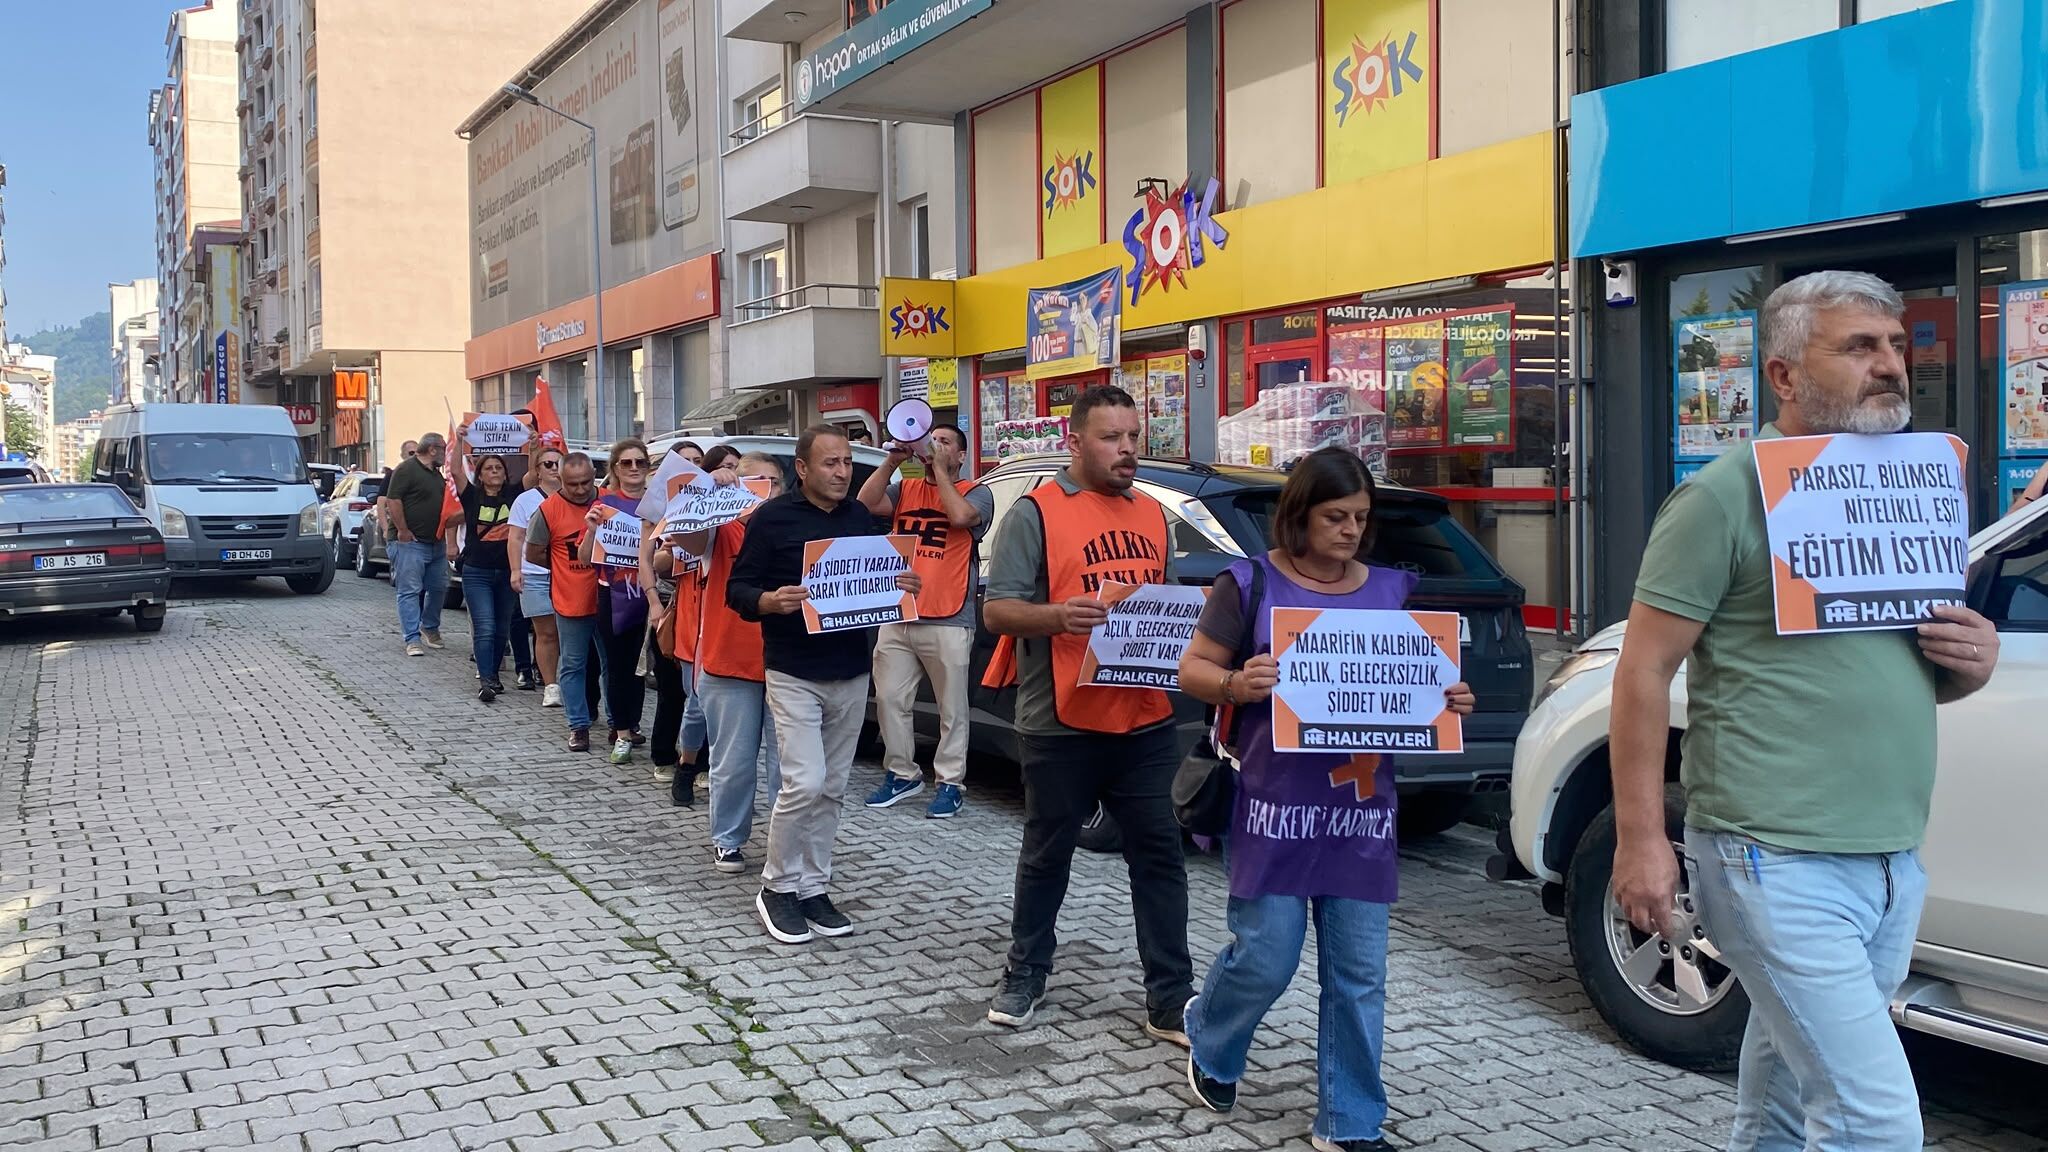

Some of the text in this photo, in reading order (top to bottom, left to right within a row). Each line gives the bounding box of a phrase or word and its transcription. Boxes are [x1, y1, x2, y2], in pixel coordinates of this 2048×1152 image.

[857, 39, 881, 64] ORTAK
[881, 23, 908, 52] SAĞLIK
[908, 17, 919, 36] VE
[1333, 30, 1424, 128] ŞOK
[476, 137, 514, 185] Bankkart
[550, 84, 589, 133] hemen
[591, 32, 637, 103] indirin!
[1044, 149, 1097, 220] ŞOK
[1122, 176, 1230, 307] ŞOK
[889, 302, 951, 340] ŞOK
[1031, 333, 1050, 363] 100
[474, 421, 522, 432] YUSUF TEKİN
[483, 432, 510, 443] İSTİFA!
[1788, 462, 1876, 492] PARASIZ,
[1878, 459, 1957, 492] BİLİMSEL,
[1843, 493, 1961, 527] NİTELİKLİ, EŞİT
[602, 519, 613, 530] BU
[602, 533, 628, 547] SARAY
[1082, 530, 1160, 567] HALKIN
[42, 554, 103, 568] 08 AS 216
[225, 550, 270, 559] 08 DH 406
[808, 555, 909, 580] BU ŞİDDETİ YARATAN
[1786, 530, 1967, 580] EĞİTİM İSTİYO
[809, 581, 840, 601] SARAY
[834, 607, 900, 628] HALKEVLERİ
[1103, 620, 1133, 640] AÇLIK,
[1119, 641, 1183, 662] ŞİDDET VAR!
[1289, 660, 1443, 688] AÇLIK, GELECEKSİZLİK,
[1327, 690, 1412, 717] ŞİDDET VAR!
[1327, 729, 1432, 747] HALKEVLERİ
[1326, 805, 1398, 841] KADINLA
